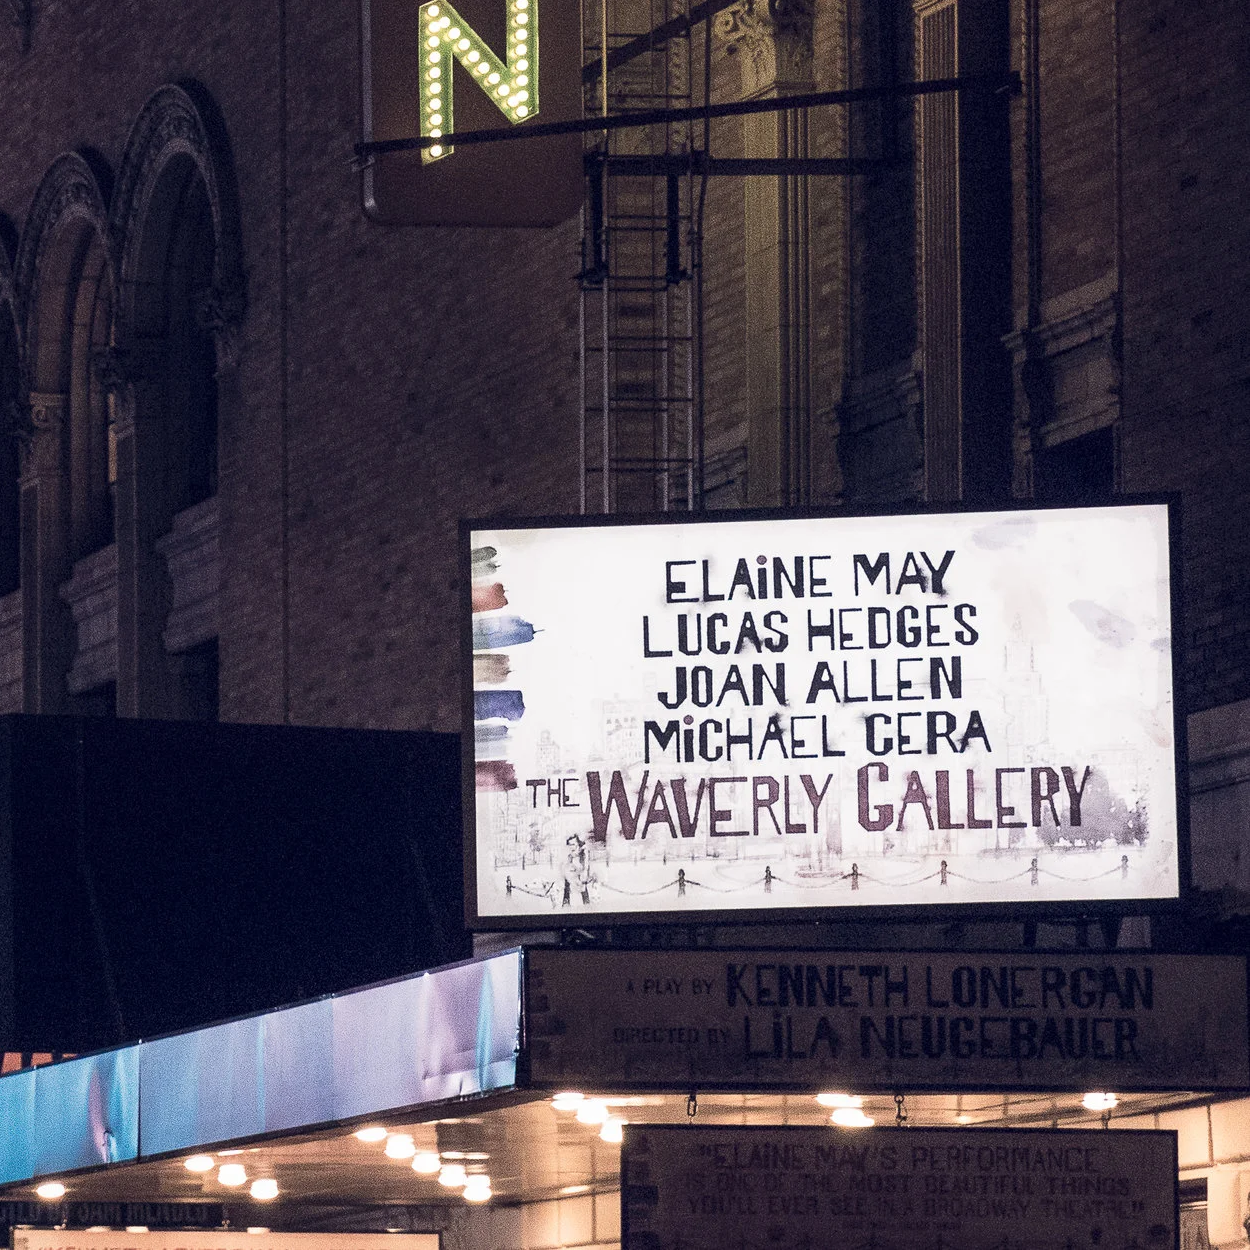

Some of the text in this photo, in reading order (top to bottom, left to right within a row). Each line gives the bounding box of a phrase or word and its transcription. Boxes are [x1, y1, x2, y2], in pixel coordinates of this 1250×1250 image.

[852, 550, 956, 598] MAY
[642, 603, 979, 658] LUCAS HEDGES
[657, 655, 962, 710] JOAN ALLEN
[863, 709, 992, 757] CERA
[526, 761, 1093, 842] THE WAVERLY GALLERY
[643, 978, 682, 994] PLAY
[691, 978, 713, 994] BY
[726, 963, 909, 1007] KENNETH
[926, 965, 1153, 1010] LONERGAN
[612, 1026, 699, 1044] DIRECTED
[706, 1027, 730, 1045] BY
[859, 1014, 1141, 1061] NEUGEBAUER
[911, 1145, 1100, 1172] PERFORMANCE
[768, 1196, 819, 1215] EVER
[829, 1195, 867, 1216] SEE
[923, 1198, 1030, 1218] BROADWAY
[849, 1174, 911, 1194] MOST
